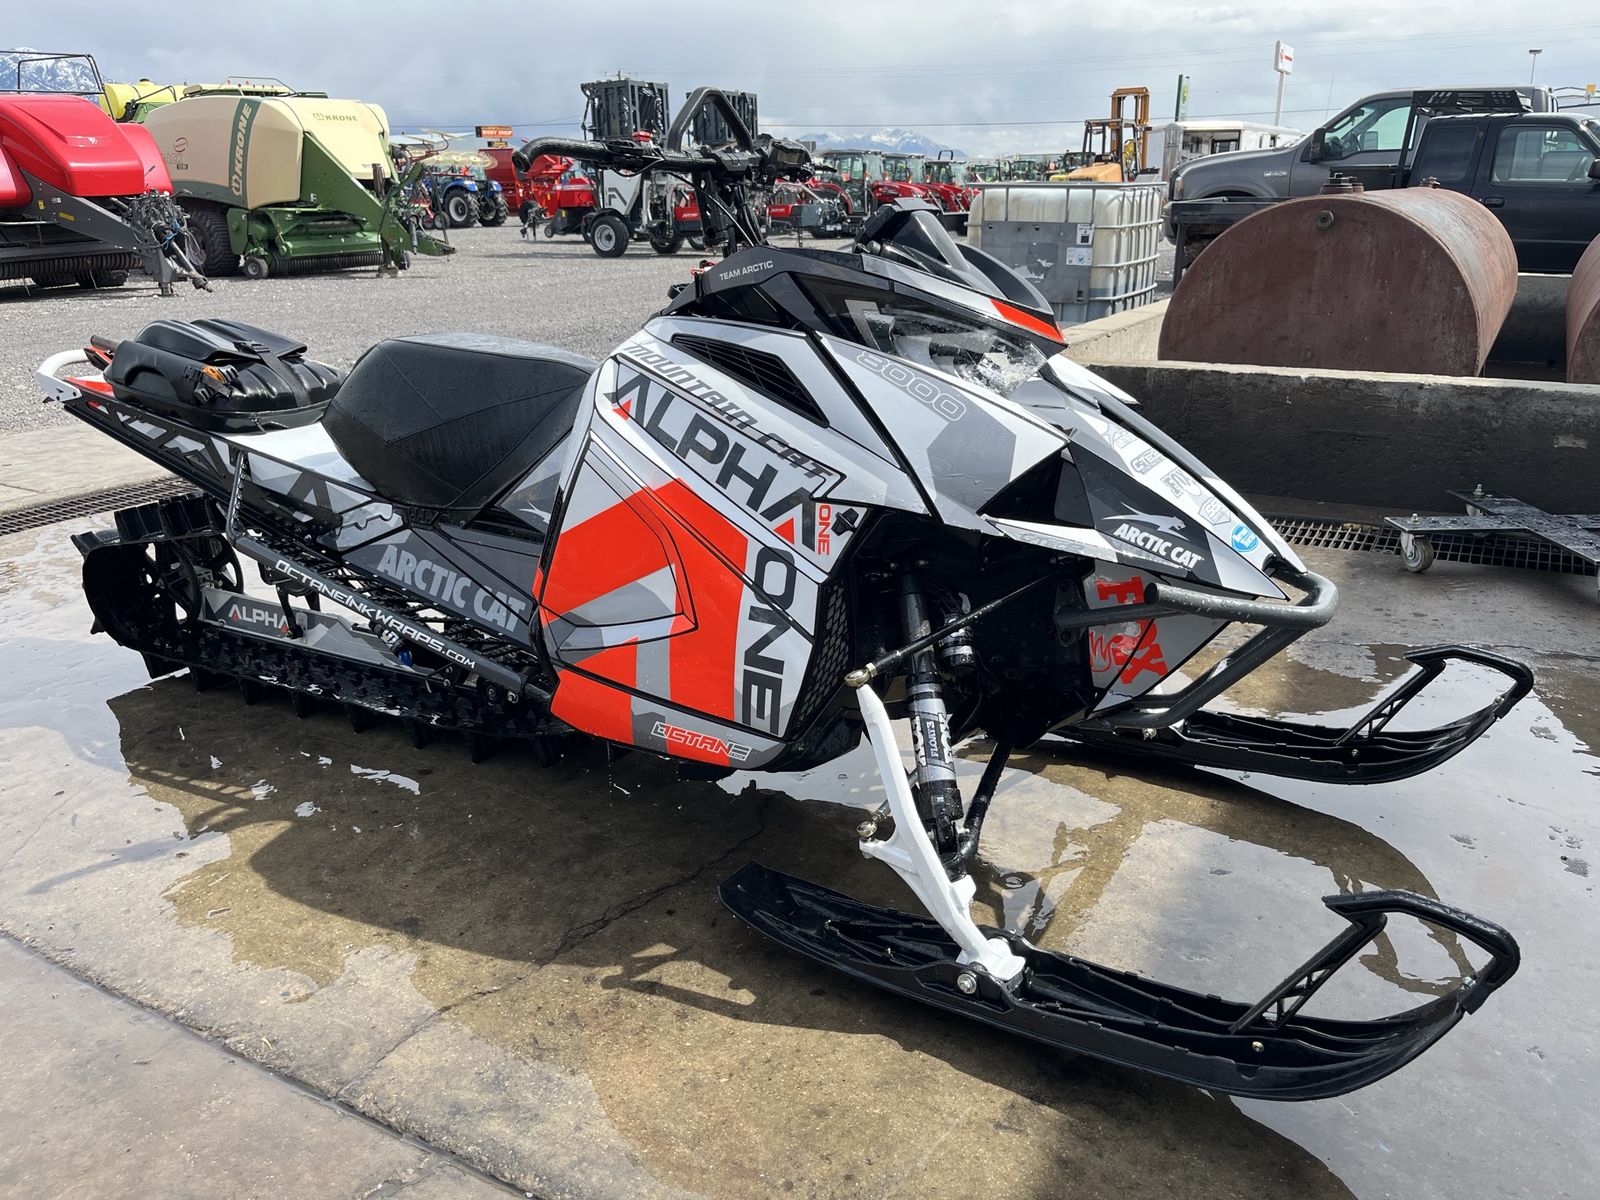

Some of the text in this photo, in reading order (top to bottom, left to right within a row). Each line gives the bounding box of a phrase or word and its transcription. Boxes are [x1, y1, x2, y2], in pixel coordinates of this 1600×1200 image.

[234, 103, 252, 179] KRONE
[719, 260, 774, 281] TEAM ARCTIC
[856, 350, 967, 421] 8000
[603, 372, 817, 553] ALPHA
[757, 432, 834, 479] CAT
[817, 503, 832, 556] ONE
[1113, 523, 1201, 569] ARCTIC CAT
[228, 604, 289, 634] ALPHA
[376, 545, 526, 632] ARCTIC CAT
[742, 546, 798, 736] ONE
